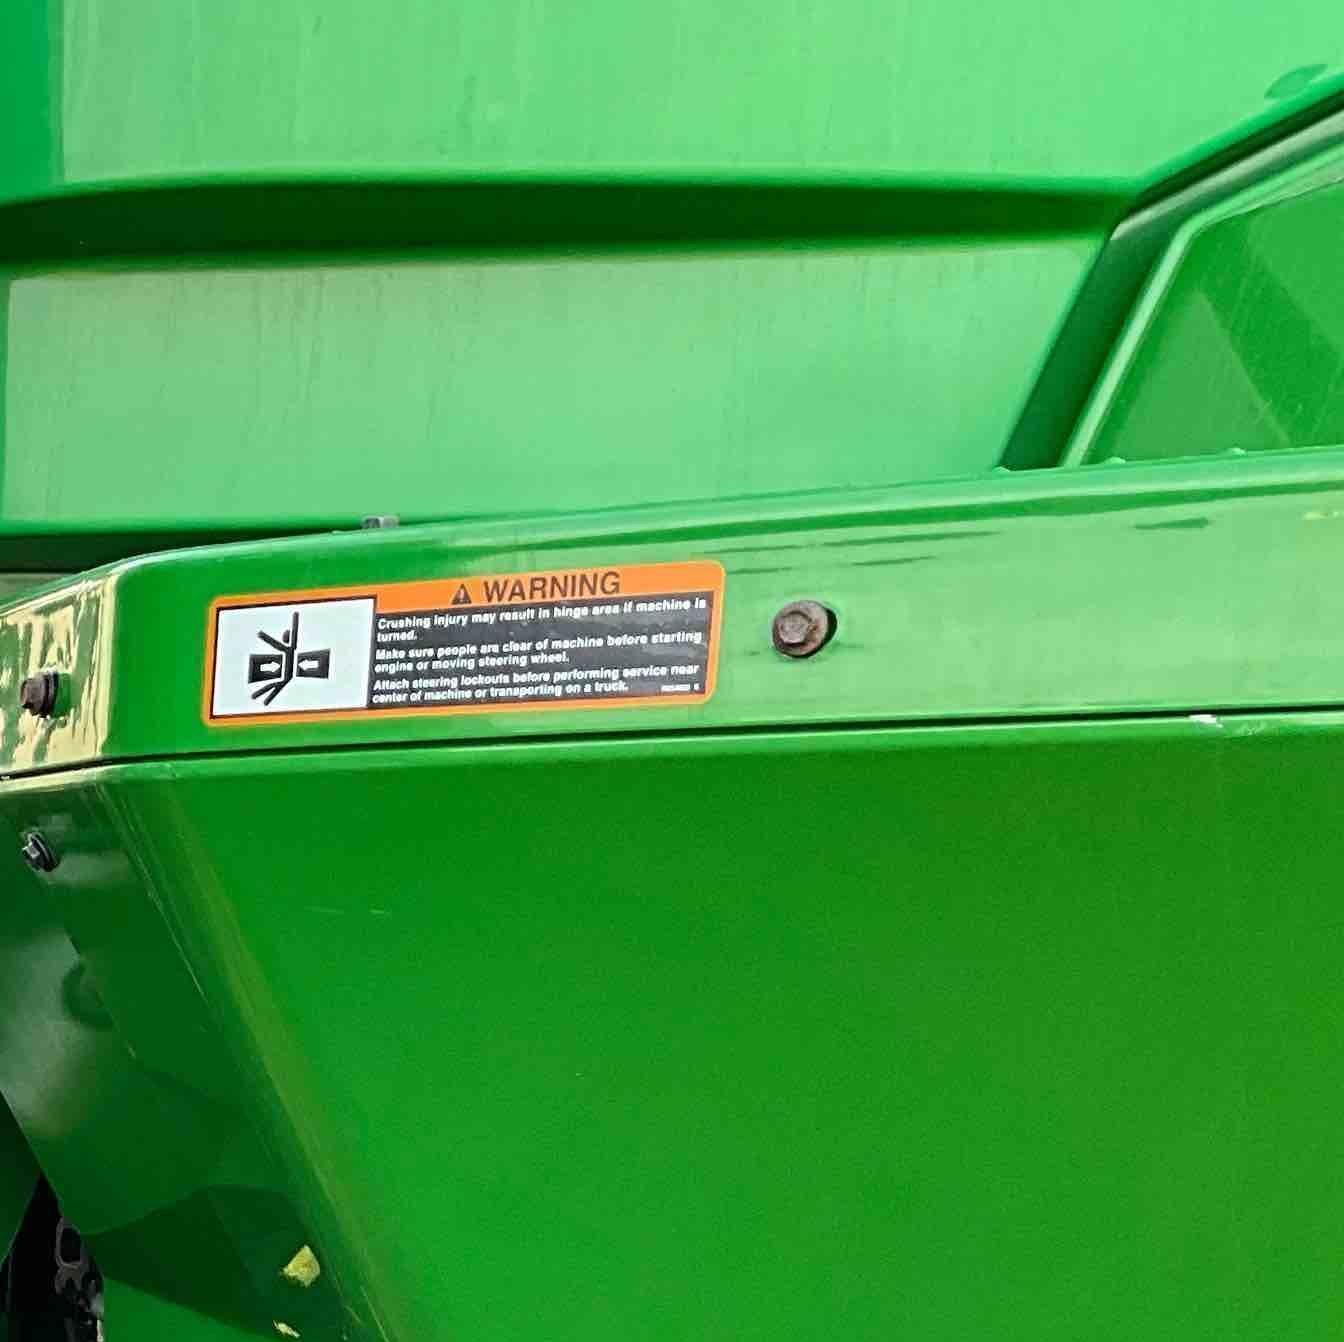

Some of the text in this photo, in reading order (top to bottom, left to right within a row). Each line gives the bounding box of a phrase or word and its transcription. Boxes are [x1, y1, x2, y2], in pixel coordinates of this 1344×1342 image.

[483, 570, 621, 603] WARNING
[378, 598, 706, 629] Crushing injury may result in hinge area if machine is
[375, 631, 702, 660] Make sure people are clear of machine before starting
[377, 630, 418, 642] turned.
[374, 651, 569, 674] engine or moving steering wheel.
[373, 664, 700, 690] Attach steering lockouts before performing service near
[373, 680, 629, 703] center of machine or transporting on a truck.
